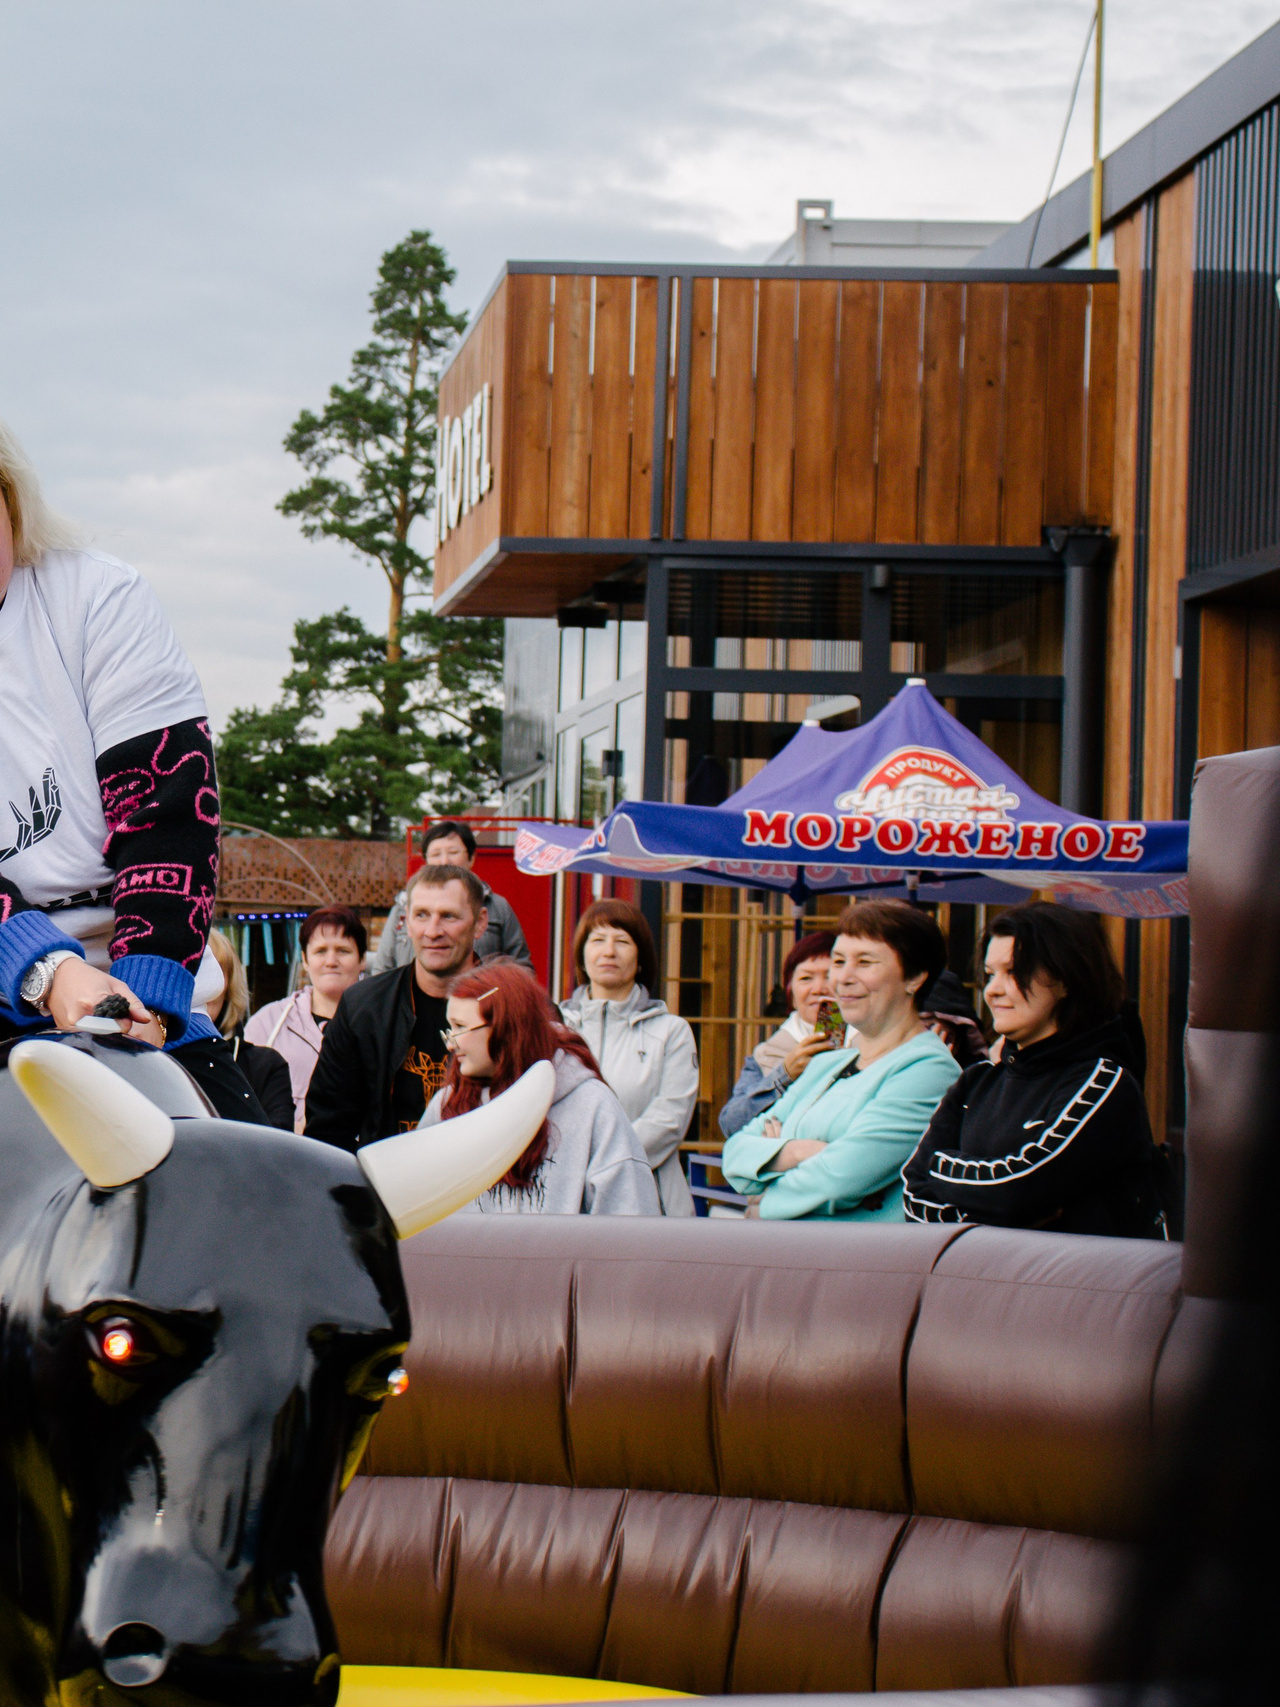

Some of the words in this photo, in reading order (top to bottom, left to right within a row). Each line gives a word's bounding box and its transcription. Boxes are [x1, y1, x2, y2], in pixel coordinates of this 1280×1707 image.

[435, 382, 491, 549] HOTEL
[884, 757, 967, 783] ПРОДУКТ
[835, 783, 1019, 814] Чистая
[743, 809, 1146, 863] МОРОЖЕНОЕ
